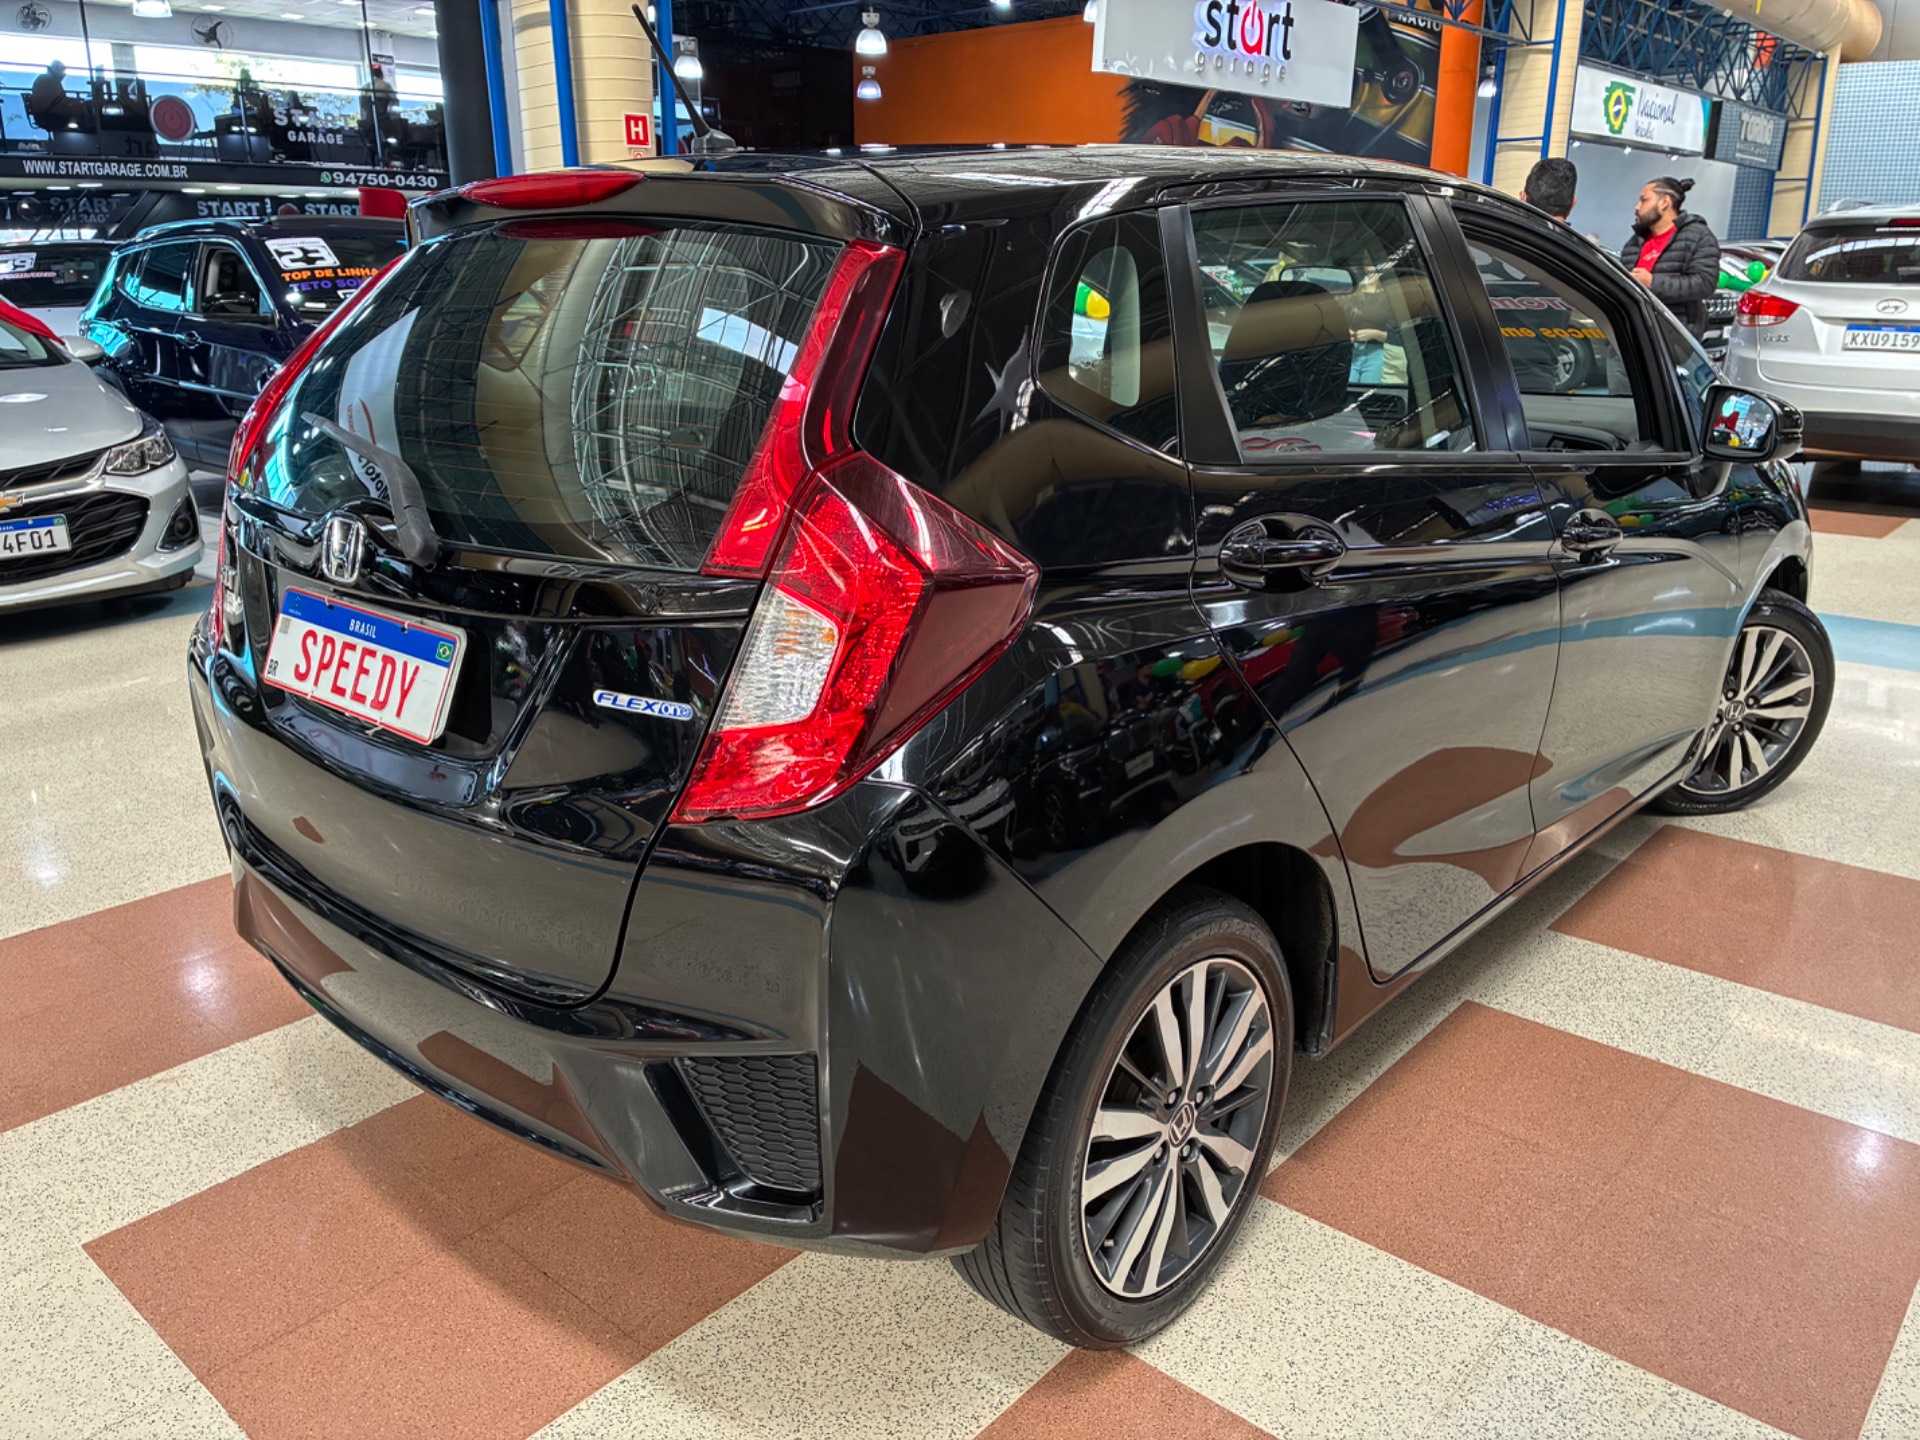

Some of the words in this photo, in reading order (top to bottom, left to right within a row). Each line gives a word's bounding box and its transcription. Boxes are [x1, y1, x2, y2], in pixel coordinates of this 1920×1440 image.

[1204, 0, 1294, 60] start
[1193, 51, 1287, 83] garage
[287, 130, 345, 145] GARAGE
[630, 119, 644, 141] H
[22, 159, 189, 179] WWW.STARTGARAGE.COM.BR
[332, 171, 438, 188] 94750-0430
[197, 201, 260, 216] START
[275, 246, 335, 267] 23
[281, 270, 311, 282] TOP
[314, 268, 335, 278] DE
[288, 279, 333, 292] TETO
[3, 528, 58, 554] 4F01
[349, 618, 377, 638] BRASIL
[266, 658, 279, 678] BR
[293, 628, 421, 719] SPEEDY
